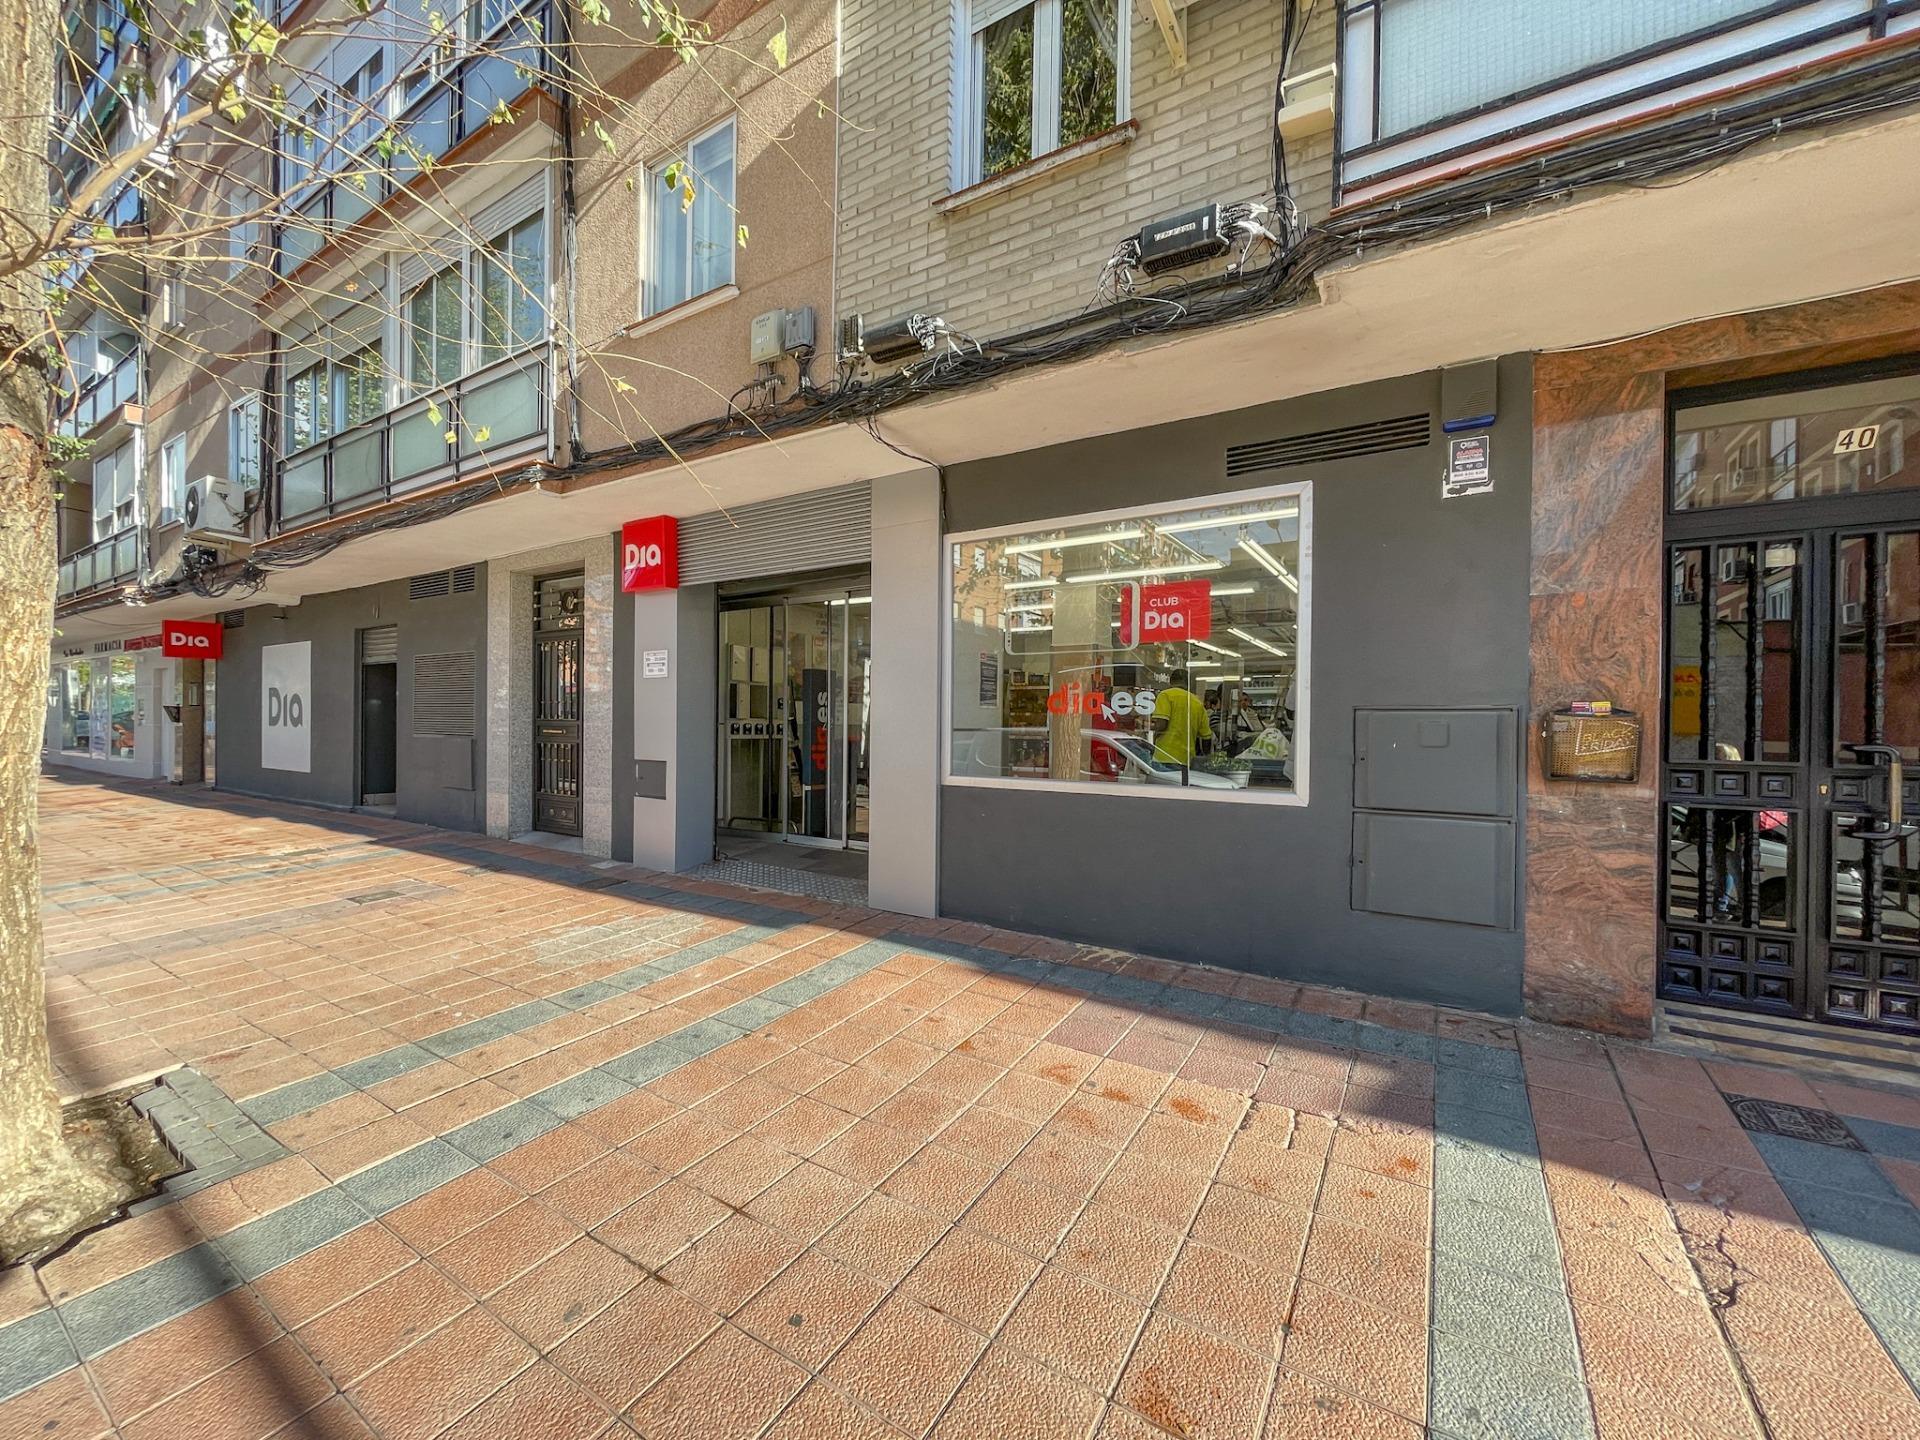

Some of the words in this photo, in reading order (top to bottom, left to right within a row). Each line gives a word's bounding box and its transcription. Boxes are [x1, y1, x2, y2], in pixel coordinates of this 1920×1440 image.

[1838, 427, 1876, 450] 40
[624, 543, 661, 570] Dia
[1149, 596, 1180, 608] CLUB
[1144, 611, 1184, 630] Dia
[170, 632, 210, 648] Dia
[267, 686, 304, 728] Dia
